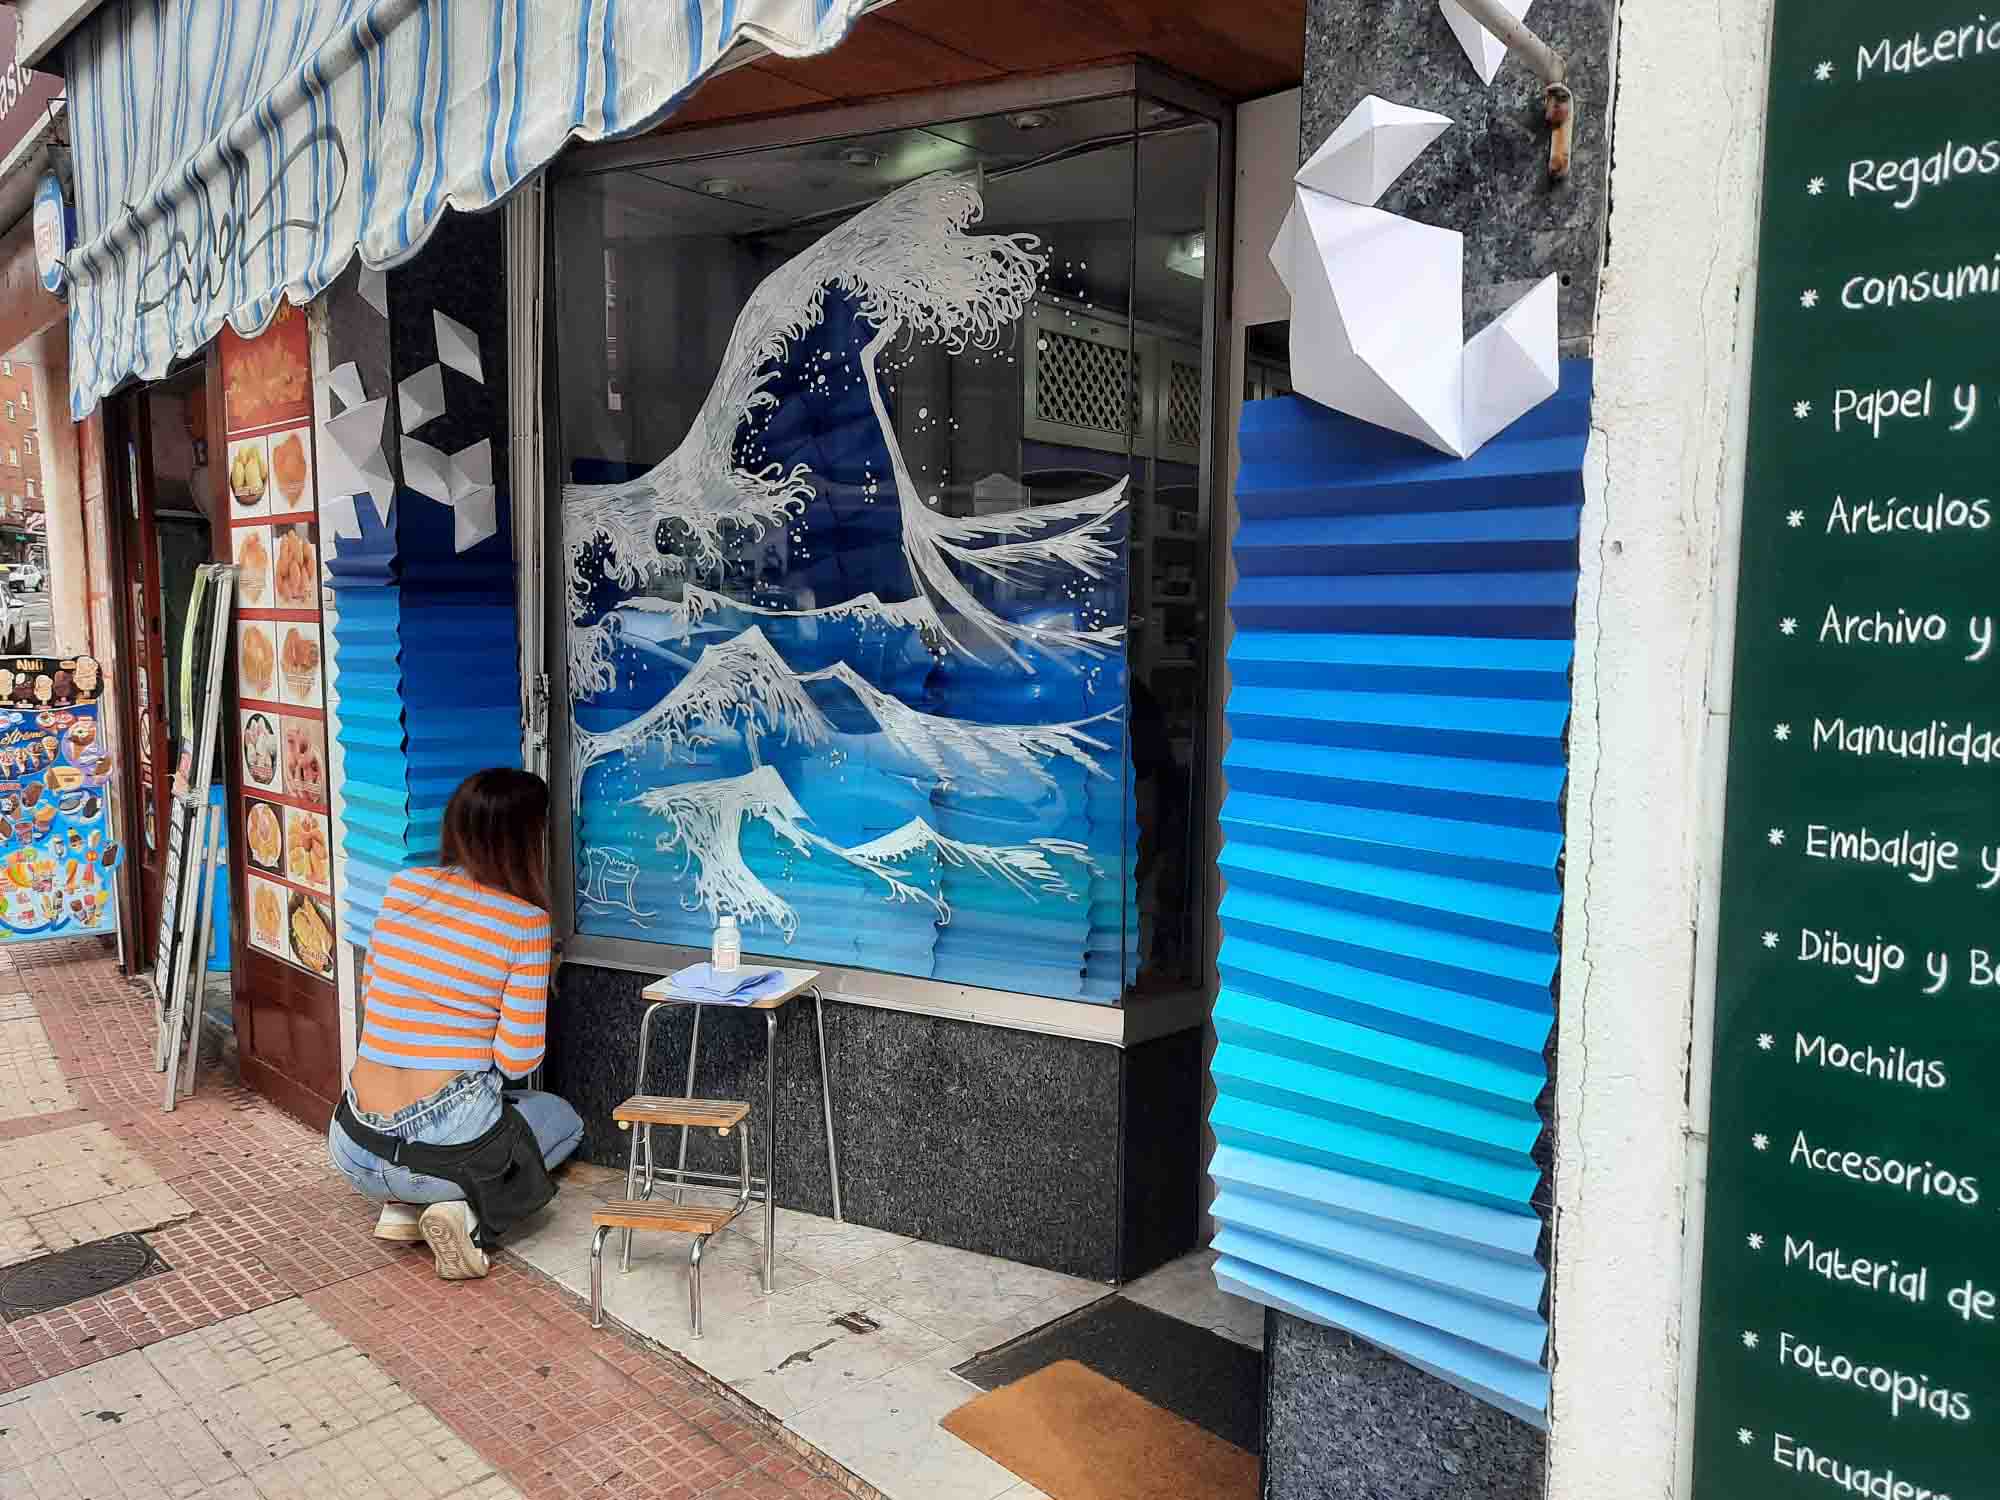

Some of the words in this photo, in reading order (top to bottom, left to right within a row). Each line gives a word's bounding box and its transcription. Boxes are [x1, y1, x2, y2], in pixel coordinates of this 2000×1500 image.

[1848, 140, 2000, 209] Regalos
[1832, 378, 1932, 438] Papel
[1948, 383, 1977, 431] y
[1826, 492, 1991, 534] Artículos
[1819, 604, 1947, 644] Archivo
[1965, 616, 1993, 661] y
[1805, 824, 1959, 883] Embalaje
[1976, 845, 2000, 889] y
[1797, 928, 1905, 986] Dibujo
[1922, 951, 1948, 994] y
[1969, 948, 2000, 986] B
[1795, 1031, 1946, 1089] Mochilas
[1789, 1130, 1979, 1204] Accesorios
[1784, 1234, 1927, 1303] Material
[1947, 1279, 1996, 1321] de
[1779, 1331, 1971, 1421] Fotocopias
